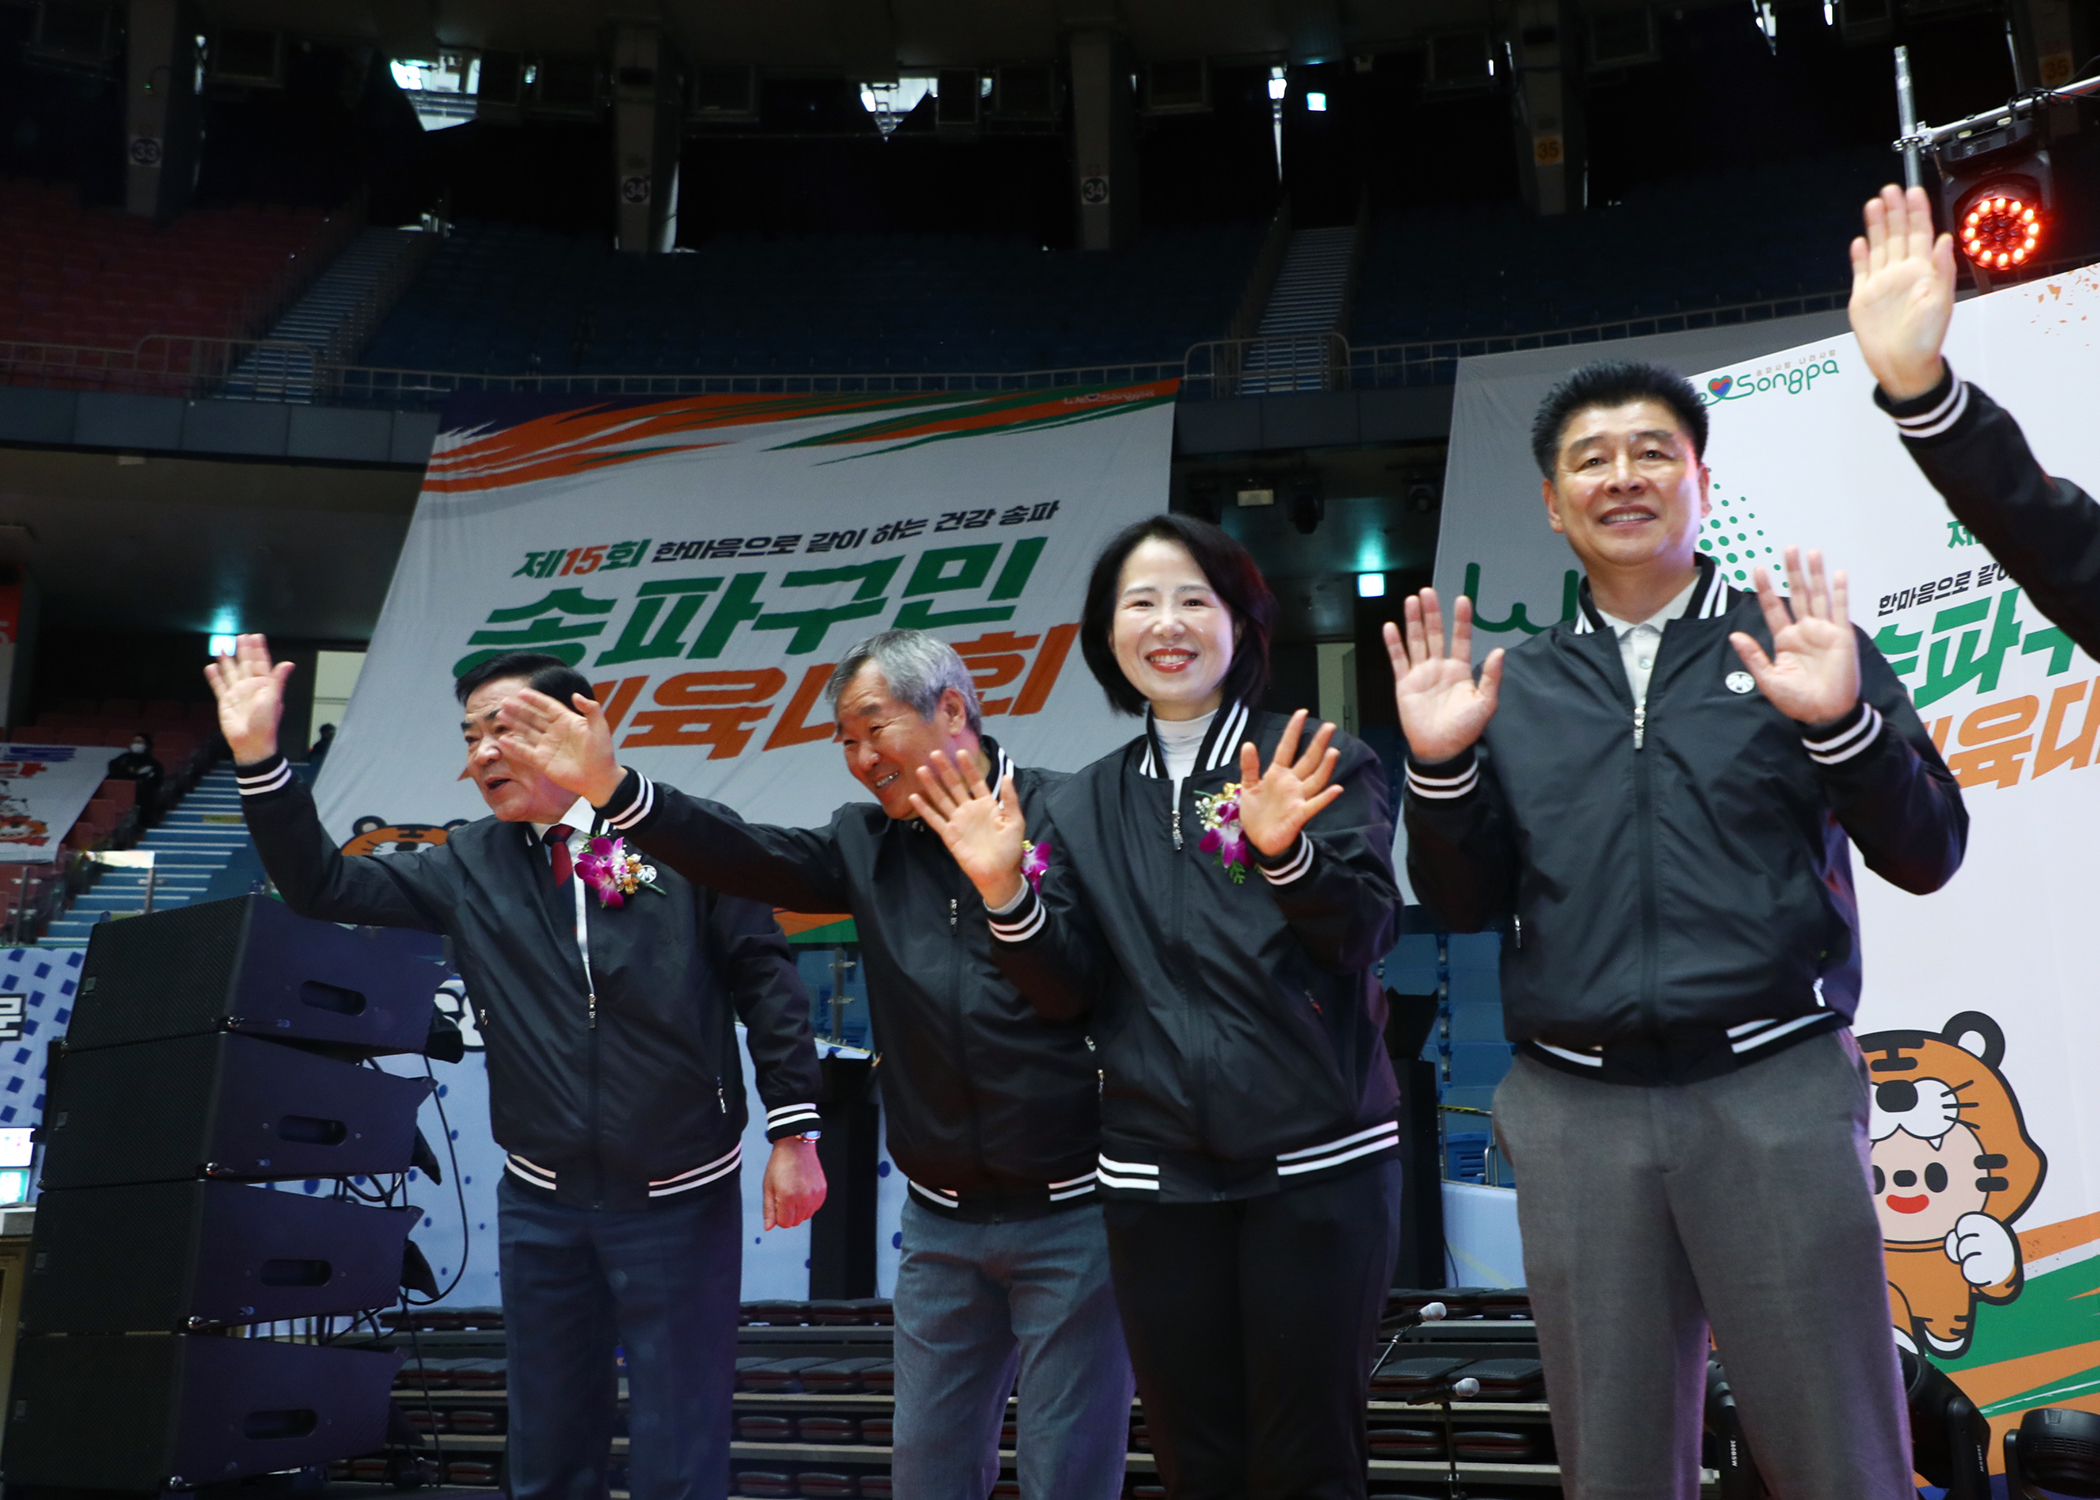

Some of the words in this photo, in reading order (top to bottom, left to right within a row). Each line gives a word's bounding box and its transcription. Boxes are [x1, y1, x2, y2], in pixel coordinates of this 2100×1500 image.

[2045, 59, 2069, 79] 35
[134, 142, 158, 161] 33
[1537, 141, 1559, 160] 35
[625, 181, 646, 199] 34
[1084, 182, 1105, 199] 34
[512, 539, 652, 578] 제15회
[652, 534, 803, 563] 한마음으로
[805, 528, 868, 553] 같이
[870, 518, 929, 545] 하는
[933, 508, 996, 533] 건강
[998, 500, 1060, 526] 송파
[1877, 570, 1972, 617] 한마음으로
[452, 536, 1048, 678] 송파구민
